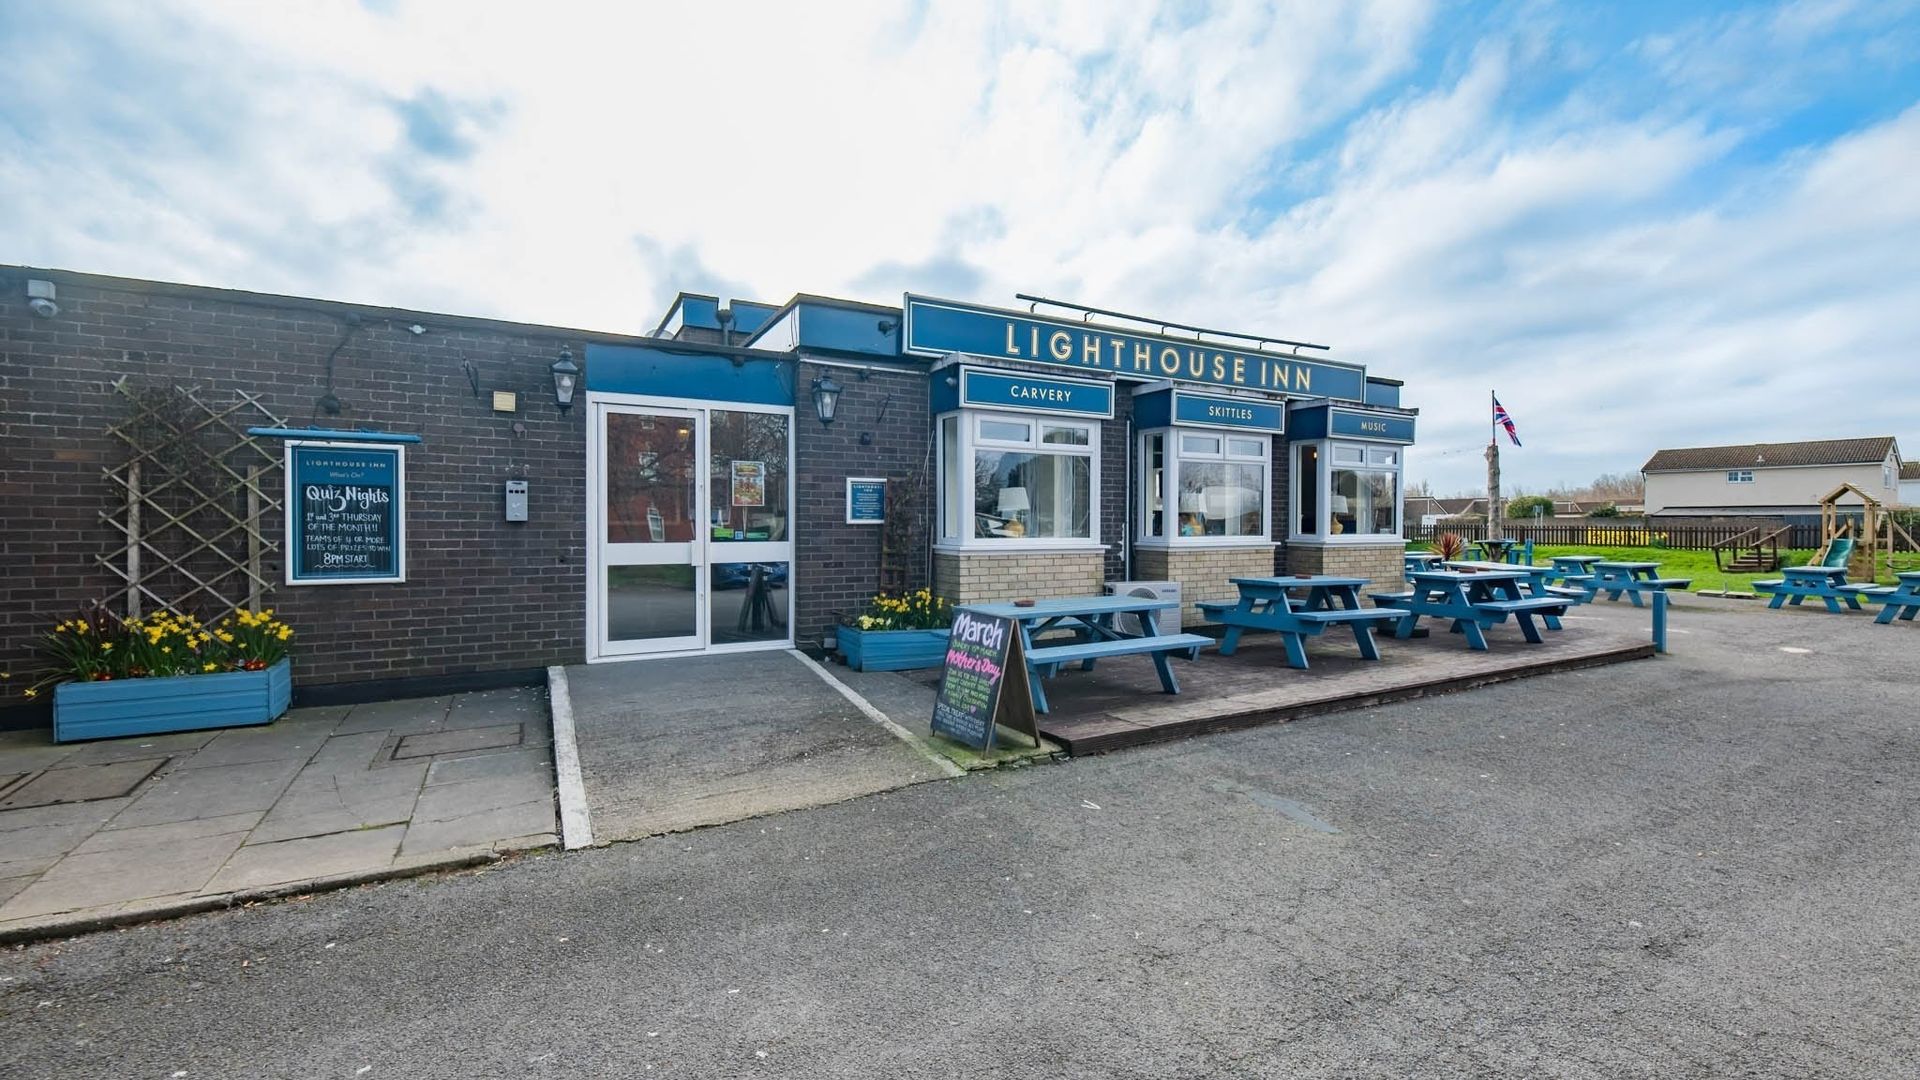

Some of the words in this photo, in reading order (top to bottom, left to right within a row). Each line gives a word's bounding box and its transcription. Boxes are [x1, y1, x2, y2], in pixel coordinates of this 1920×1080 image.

[1006, 322, 1245, 384] LIGHTHOUSE
[1260, 360, 1311, 391] INN
[1010, 385, 1071, 402] CARVERY
[1208, 405, 1253, 420] SKITTLES
[1360, 421, 1387, 432] MUSIC
[329, 471, 350, 479] What's
[306, 485, 347, 511] Quiz
[345, 486, 389, 509] Nights
[341, 512, 382, 522] THURSDAY
[307, 523, 319, 531] OF
[321, 523, 335, 531] THE
[305, 535, 332, 543] TEAMS
[333, 535, 342, 543] OF
[323, 552, 343, 565] 8PM
[344, 554, 368, 563] START
[953, 612, 1004, 650] March
[946, 649, 981, 672] Mother's
[981, 658, 1002, 686] Day
